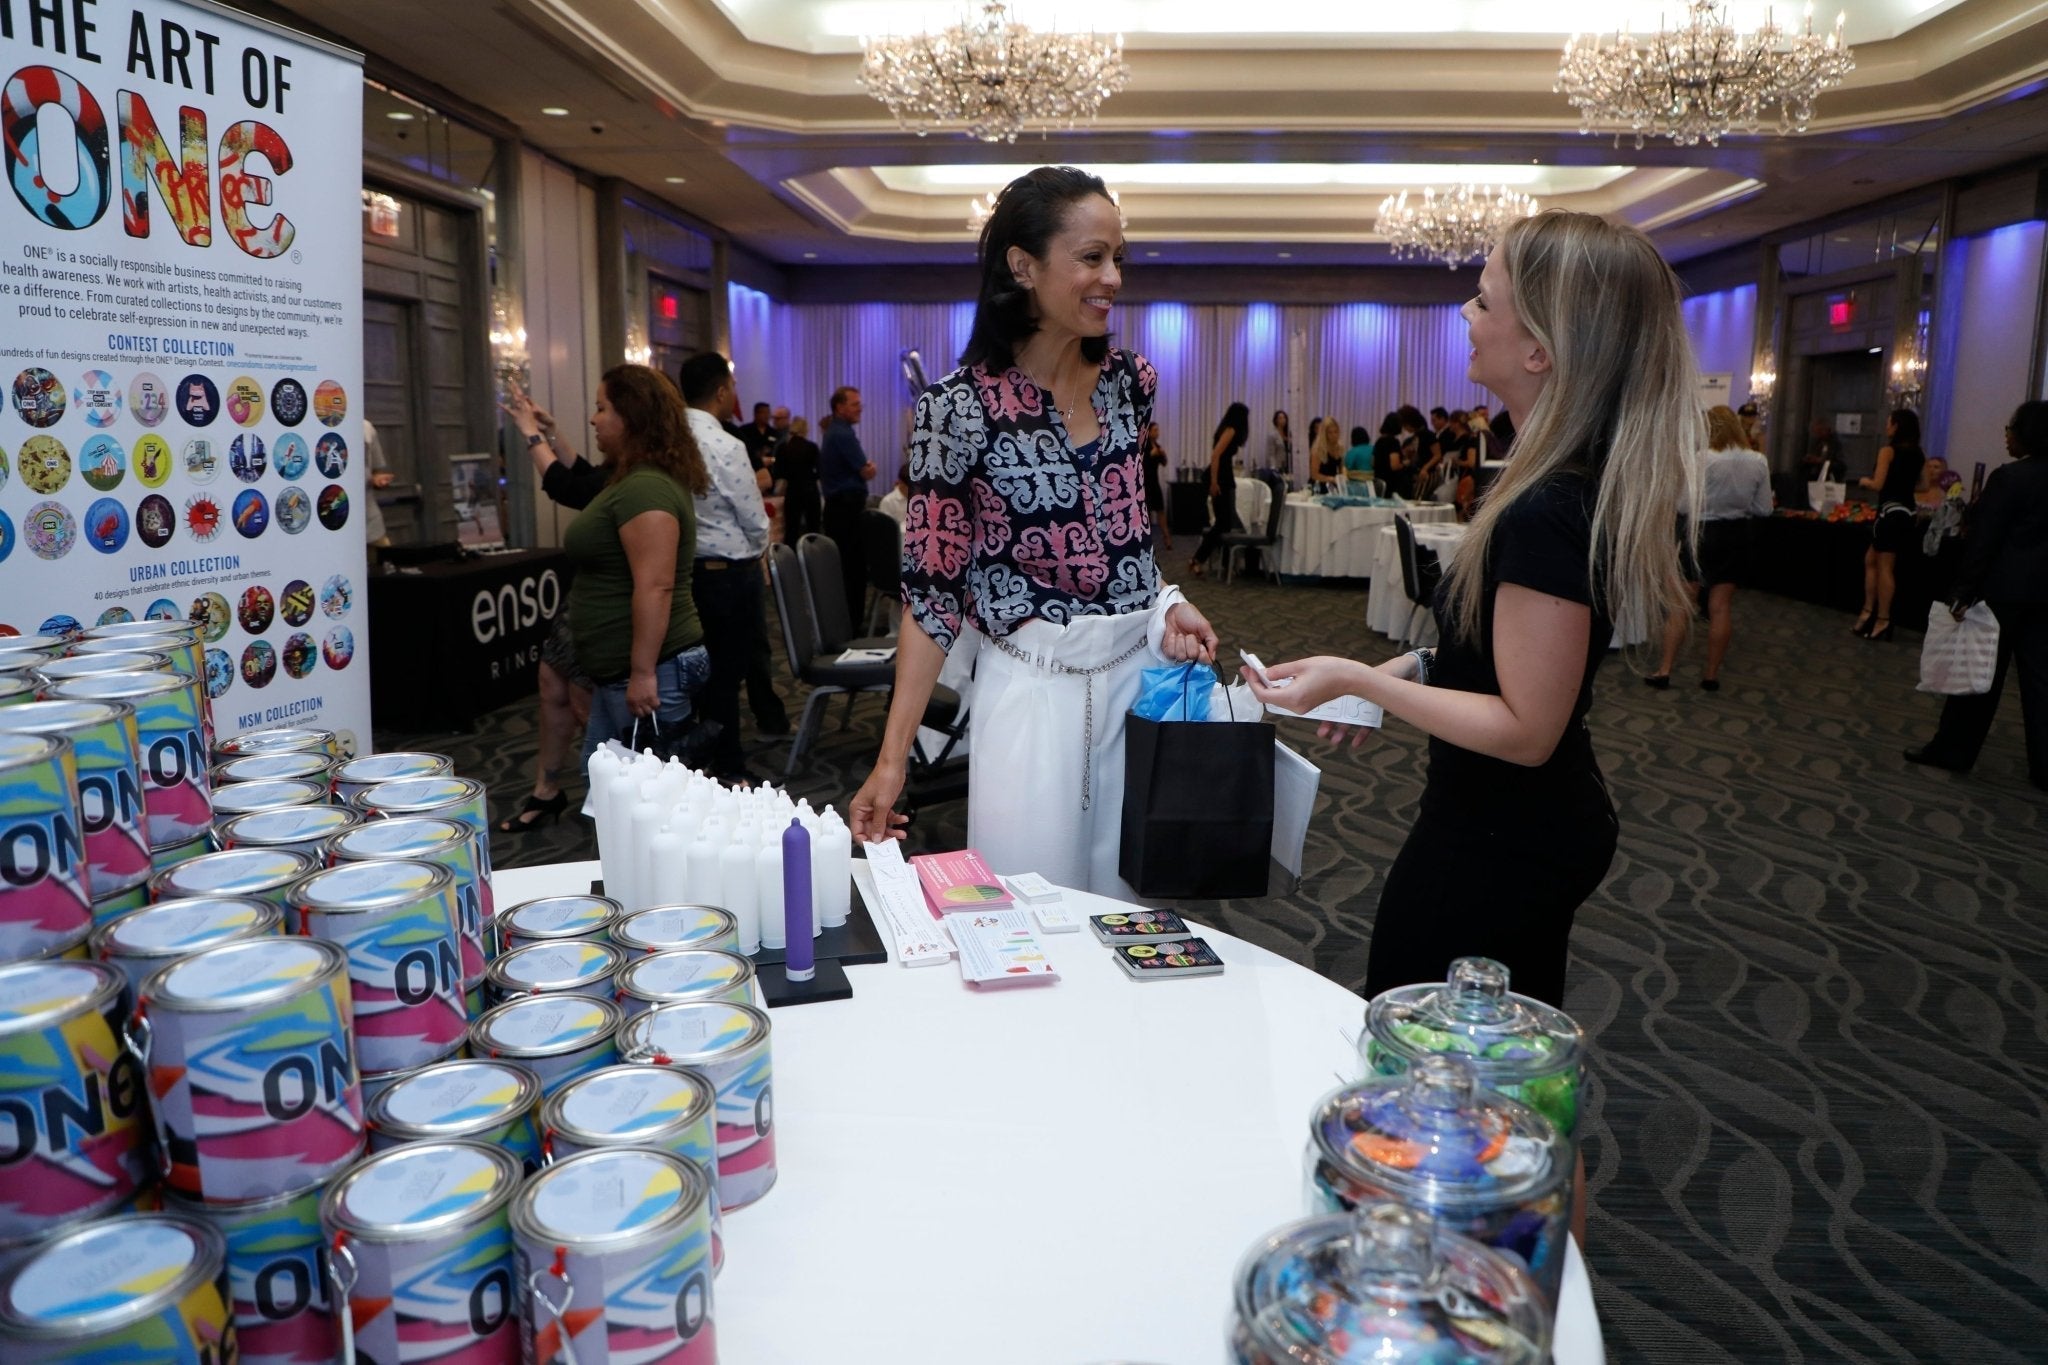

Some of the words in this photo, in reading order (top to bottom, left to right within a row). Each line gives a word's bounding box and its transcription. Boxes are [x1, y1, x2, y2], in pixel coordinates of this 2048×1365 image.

[126, 9, 220, 95] ART
[242, 47, 292, 114] OF
[2, 260, 39, 278] health
[42, 268, 103, 285] awareness.
[106, 273, 121, 287] We
[123, 276, 145, 290] work
[146, 278, 166, 292] with
[168, 282, 201, 297] artists,
[203, 285, 231, 299] health
[233, 289, 269, 304] activists,
[271, 294, 287, 305] and
[288, 297, 301, 306] our
[303, 298, 342, 311] customers
[56, 248, 66, 262] is
[69, 253, 77, 263] a
[79, 253, 118, 271] socially
[120, 258, 172, 276] responsible
[174, 264, 216, 281] business
[218, 272, 263, 286] committed
[264, 277, 273, 287] to
[275, 278, 302, 293] raising
[13, 285, 20, 295] a
[23, 283, 84, 301] difference.
[86, 289, 113, 304] From
[115, 294, 149, 308] curated
[151, 299, 201, 312] collections
[204, 302, 214, 313] to
[216, 303, 248, 318] designs
[250, 306, 259, 319] by
[262, 308, 275, 319] the
[277, 311, 322, 326] community,
[324, 315, 343, 326] we're
[19, 304, 51, 318] proud
[54, 306, 66, 318] to
[69, 307, 117, 322] celebrate
[119, 312, 187, 329] self-expression
[190, 317, 199, 329] in
[201, 320, 219, 331] new
[222, 321, 237, 332] and
[239, 324, 286, 338] unexpected
[287, 328, 310, 340] ways.
[0, 347, 34, 359] undreds
[35, 350, 44, 359] of
[46, 351, 59, 360] fun
[61, 351, 91, 363] designs
[92, 352, 118, 362] created
[119, 352, 144, 365] through
[144, 354, 155, 364] the
[174, 356, 197, 368] Design
[108, 334, 158, 353] CONTEST
[163, 338, 235, 357] COLLECTION
[94, 591, 103, 601] 40
[105, 588, 130, 600] designs
[130, 586, 143, 596] that
[144, 582, 170, 594] celebrate
[171, 579, 190, 590] ethnic
[191, 575, 219, 587] diversity
[220, 573, 232, 583] and
[232, 571, 249, 581] urban
[251, 568, 272, 578] themes
[130, 563, 166, 583] URBAN
[171, 555, 240, 576] COLLECTION
[471, 569, 560, 644] enso
[238, 712, 262, 730] MSM
[266, 696, 323, 722] COLLECTION
